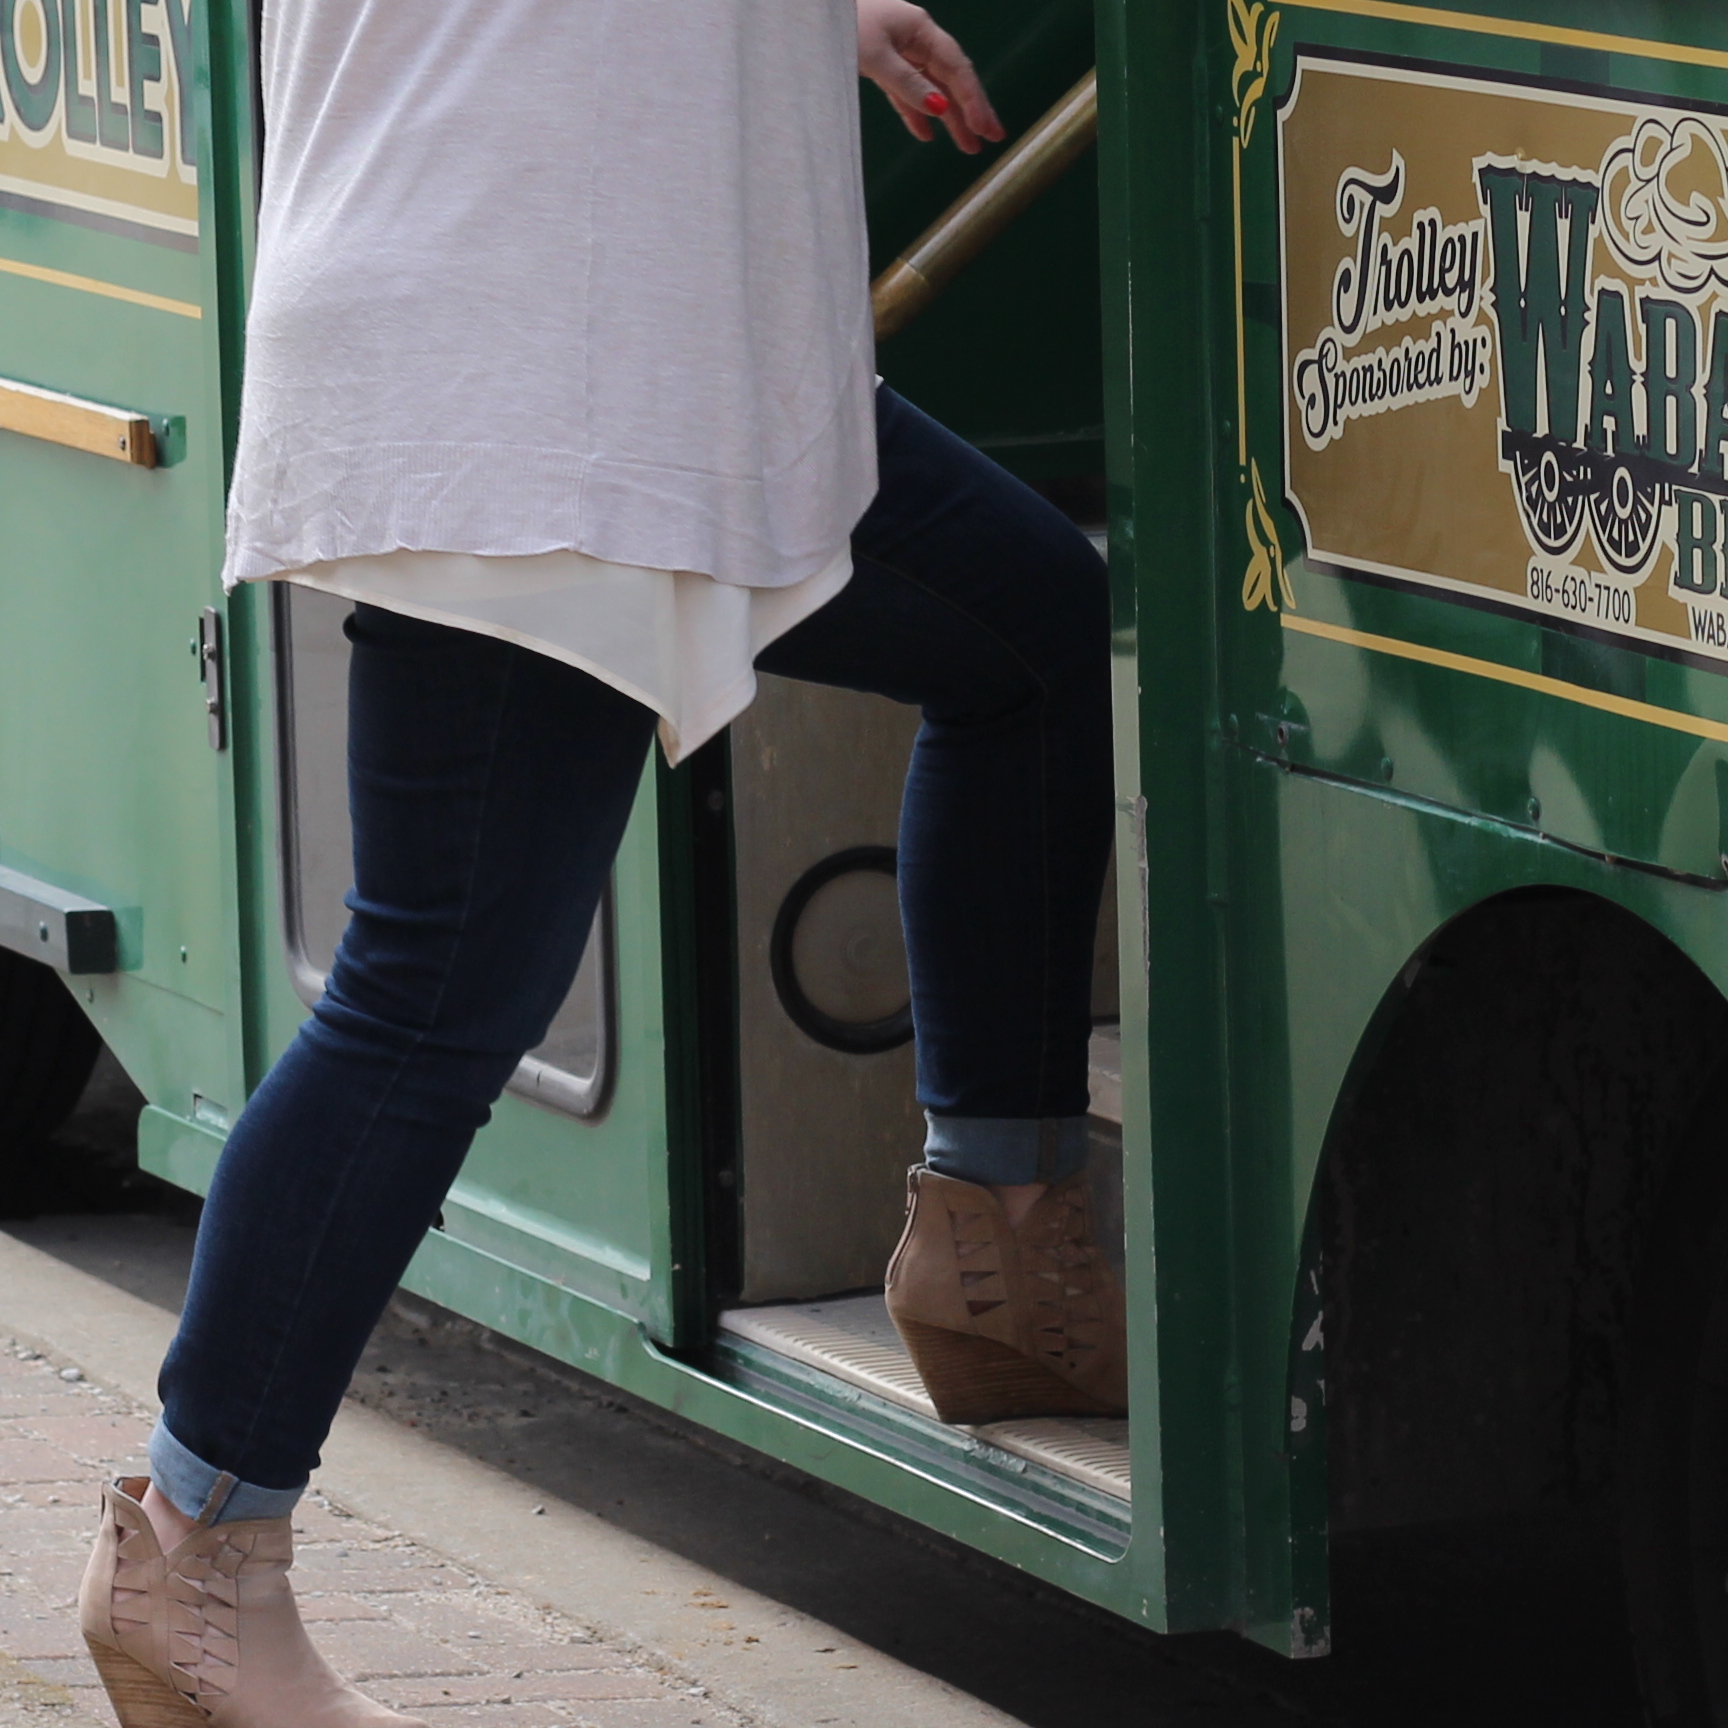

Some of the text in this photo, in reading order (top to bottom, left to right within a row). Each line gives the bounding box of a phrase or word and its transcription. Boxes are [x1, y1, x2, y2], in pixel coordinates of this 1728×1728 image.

[1336, 165, 1479, 334] Trolley
[1297, 328, 1487, 439] Sponsored by:
[1530, 566, 1632, 624] 816-630-7700
